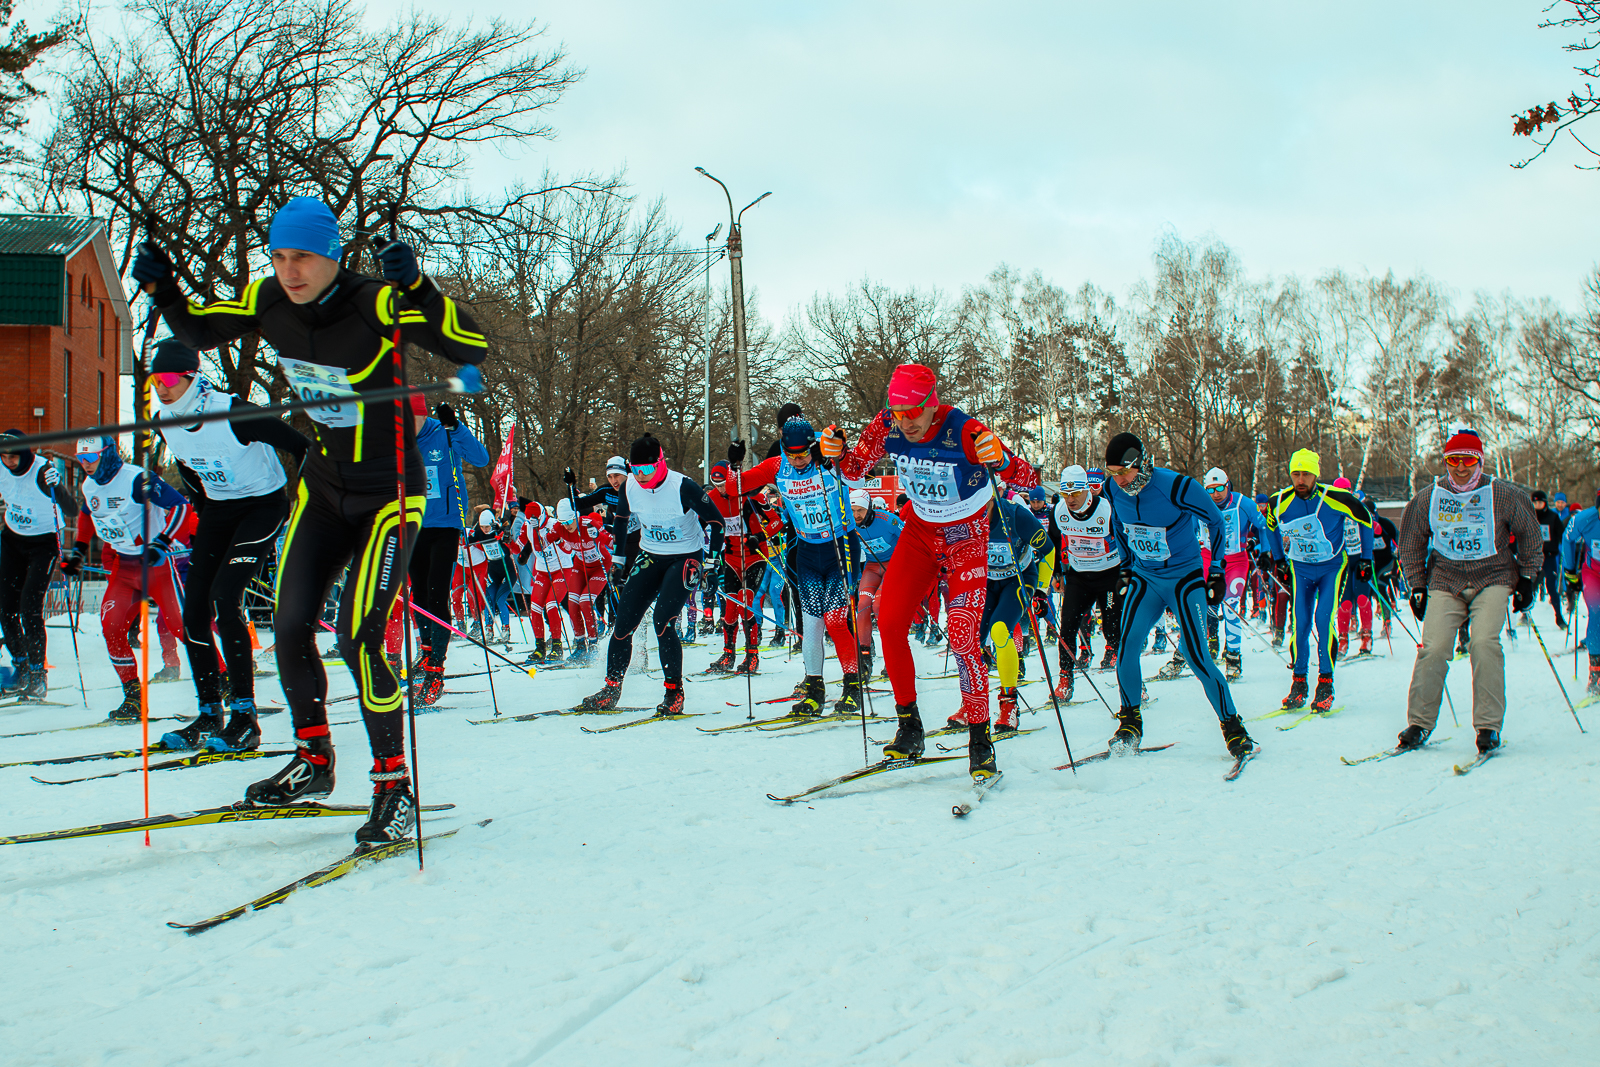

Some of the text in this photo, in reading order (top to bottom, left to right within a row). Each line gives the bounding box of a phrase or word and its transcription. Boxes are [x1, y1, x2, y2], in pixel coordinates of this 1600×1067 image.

[788, 484, 822, 495] МУЖЕСТВА
[909, 481, 947, 497] 1240
[802, 510, 831, 525] 1002
[650, 530, 677, 541] 1005
[1131, 540, 1160, 552] 1084
[1448, 539, 1481, 551] 1435
[379, 535, 398, 591] noname
[196, 752, 266, 765] FISCHER
[887, 760, 916, 771] FISCHER
[216, 809, 322, 823] FISCHER
